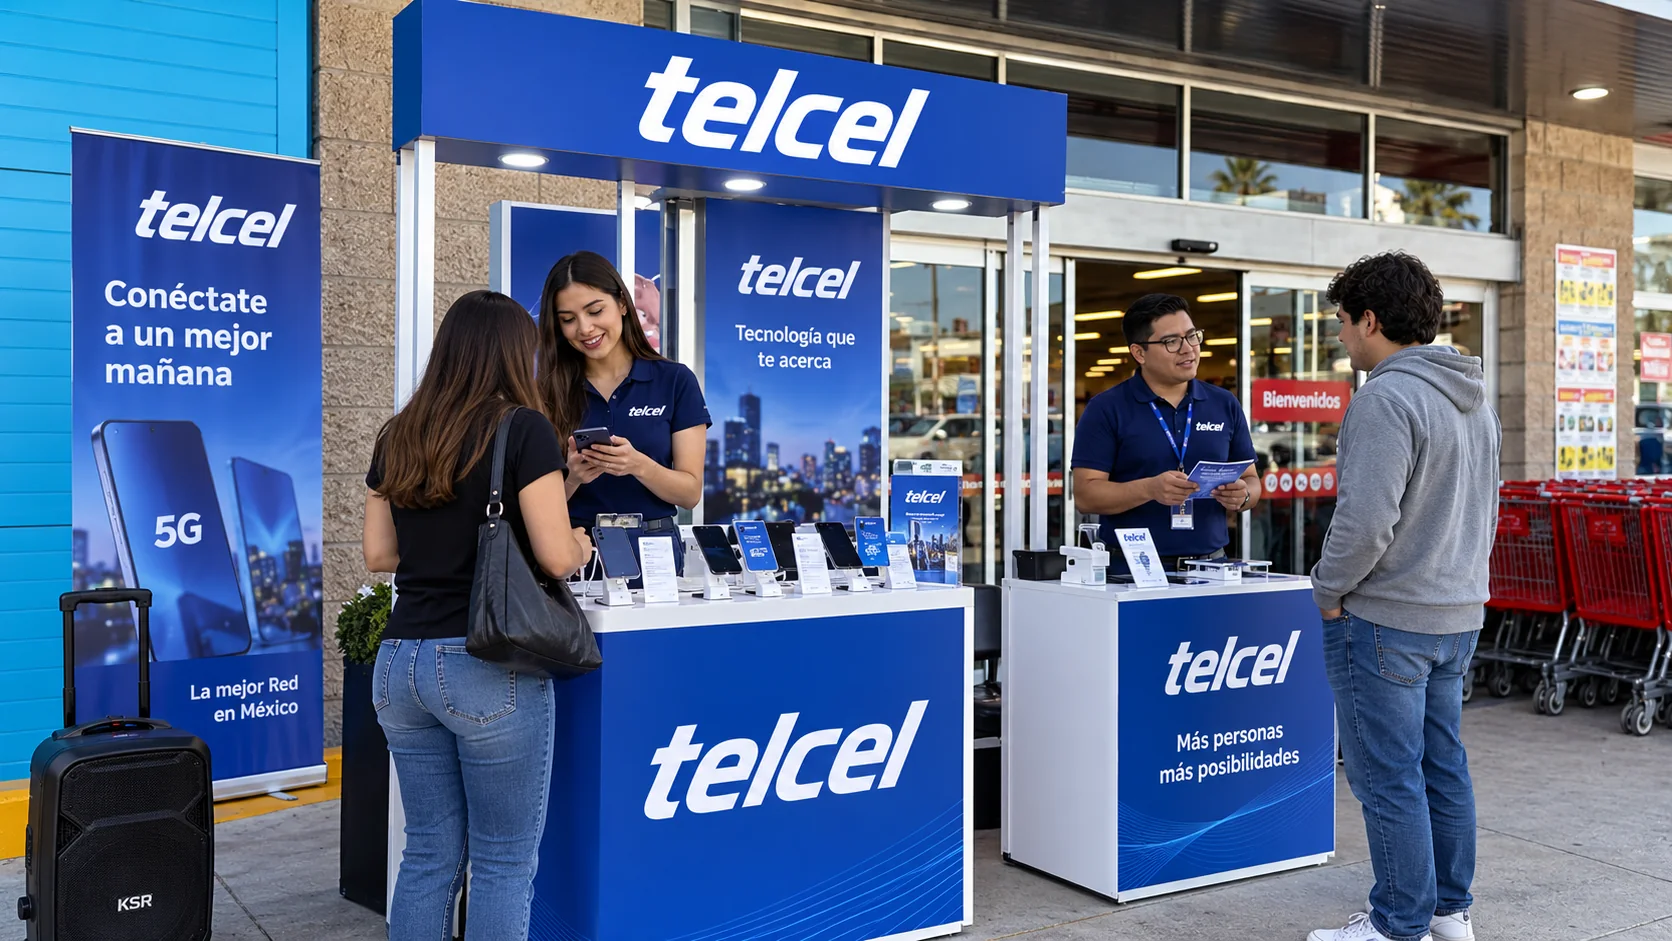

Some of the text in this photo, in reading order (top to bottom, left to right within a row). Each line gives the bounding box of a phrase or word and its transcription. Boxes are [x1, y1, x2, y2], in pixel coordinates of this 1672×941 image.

[637, 55, 931, 169] telcel
[135, 189, 297, 249] telcel
[738, 254, 862, 300] telcel
[104, 279, 268, 314] Conéctate
[105, 322, 273, 356] a un mejor
[735, 324, 856, 349] Tecnología que
[105, 357, 232, 387] mañana
[757, 351, 832, 369] te acerca
[628, 405, 667, 417] telcel
[1263, 390, 1341, 409] Bienvenidos
[1195, 421, 1225, 432] telcel
[904, 489, 947, 504] telcel
[154, 512, 202, 549] 5G
[1123, 532, 1147, 543] telcel
[1164, 629, 1302, 696] telcel
[190, 674, 299, 701] La mejor Red
[213, 699, 299, 723] en México
[1177, 723, 1284, 753] Más personas
[643, 699, 930, 820] telcel
[1159, 746, 1300, 784] más posibilidades
[117, 893, 153, 912] KSR
